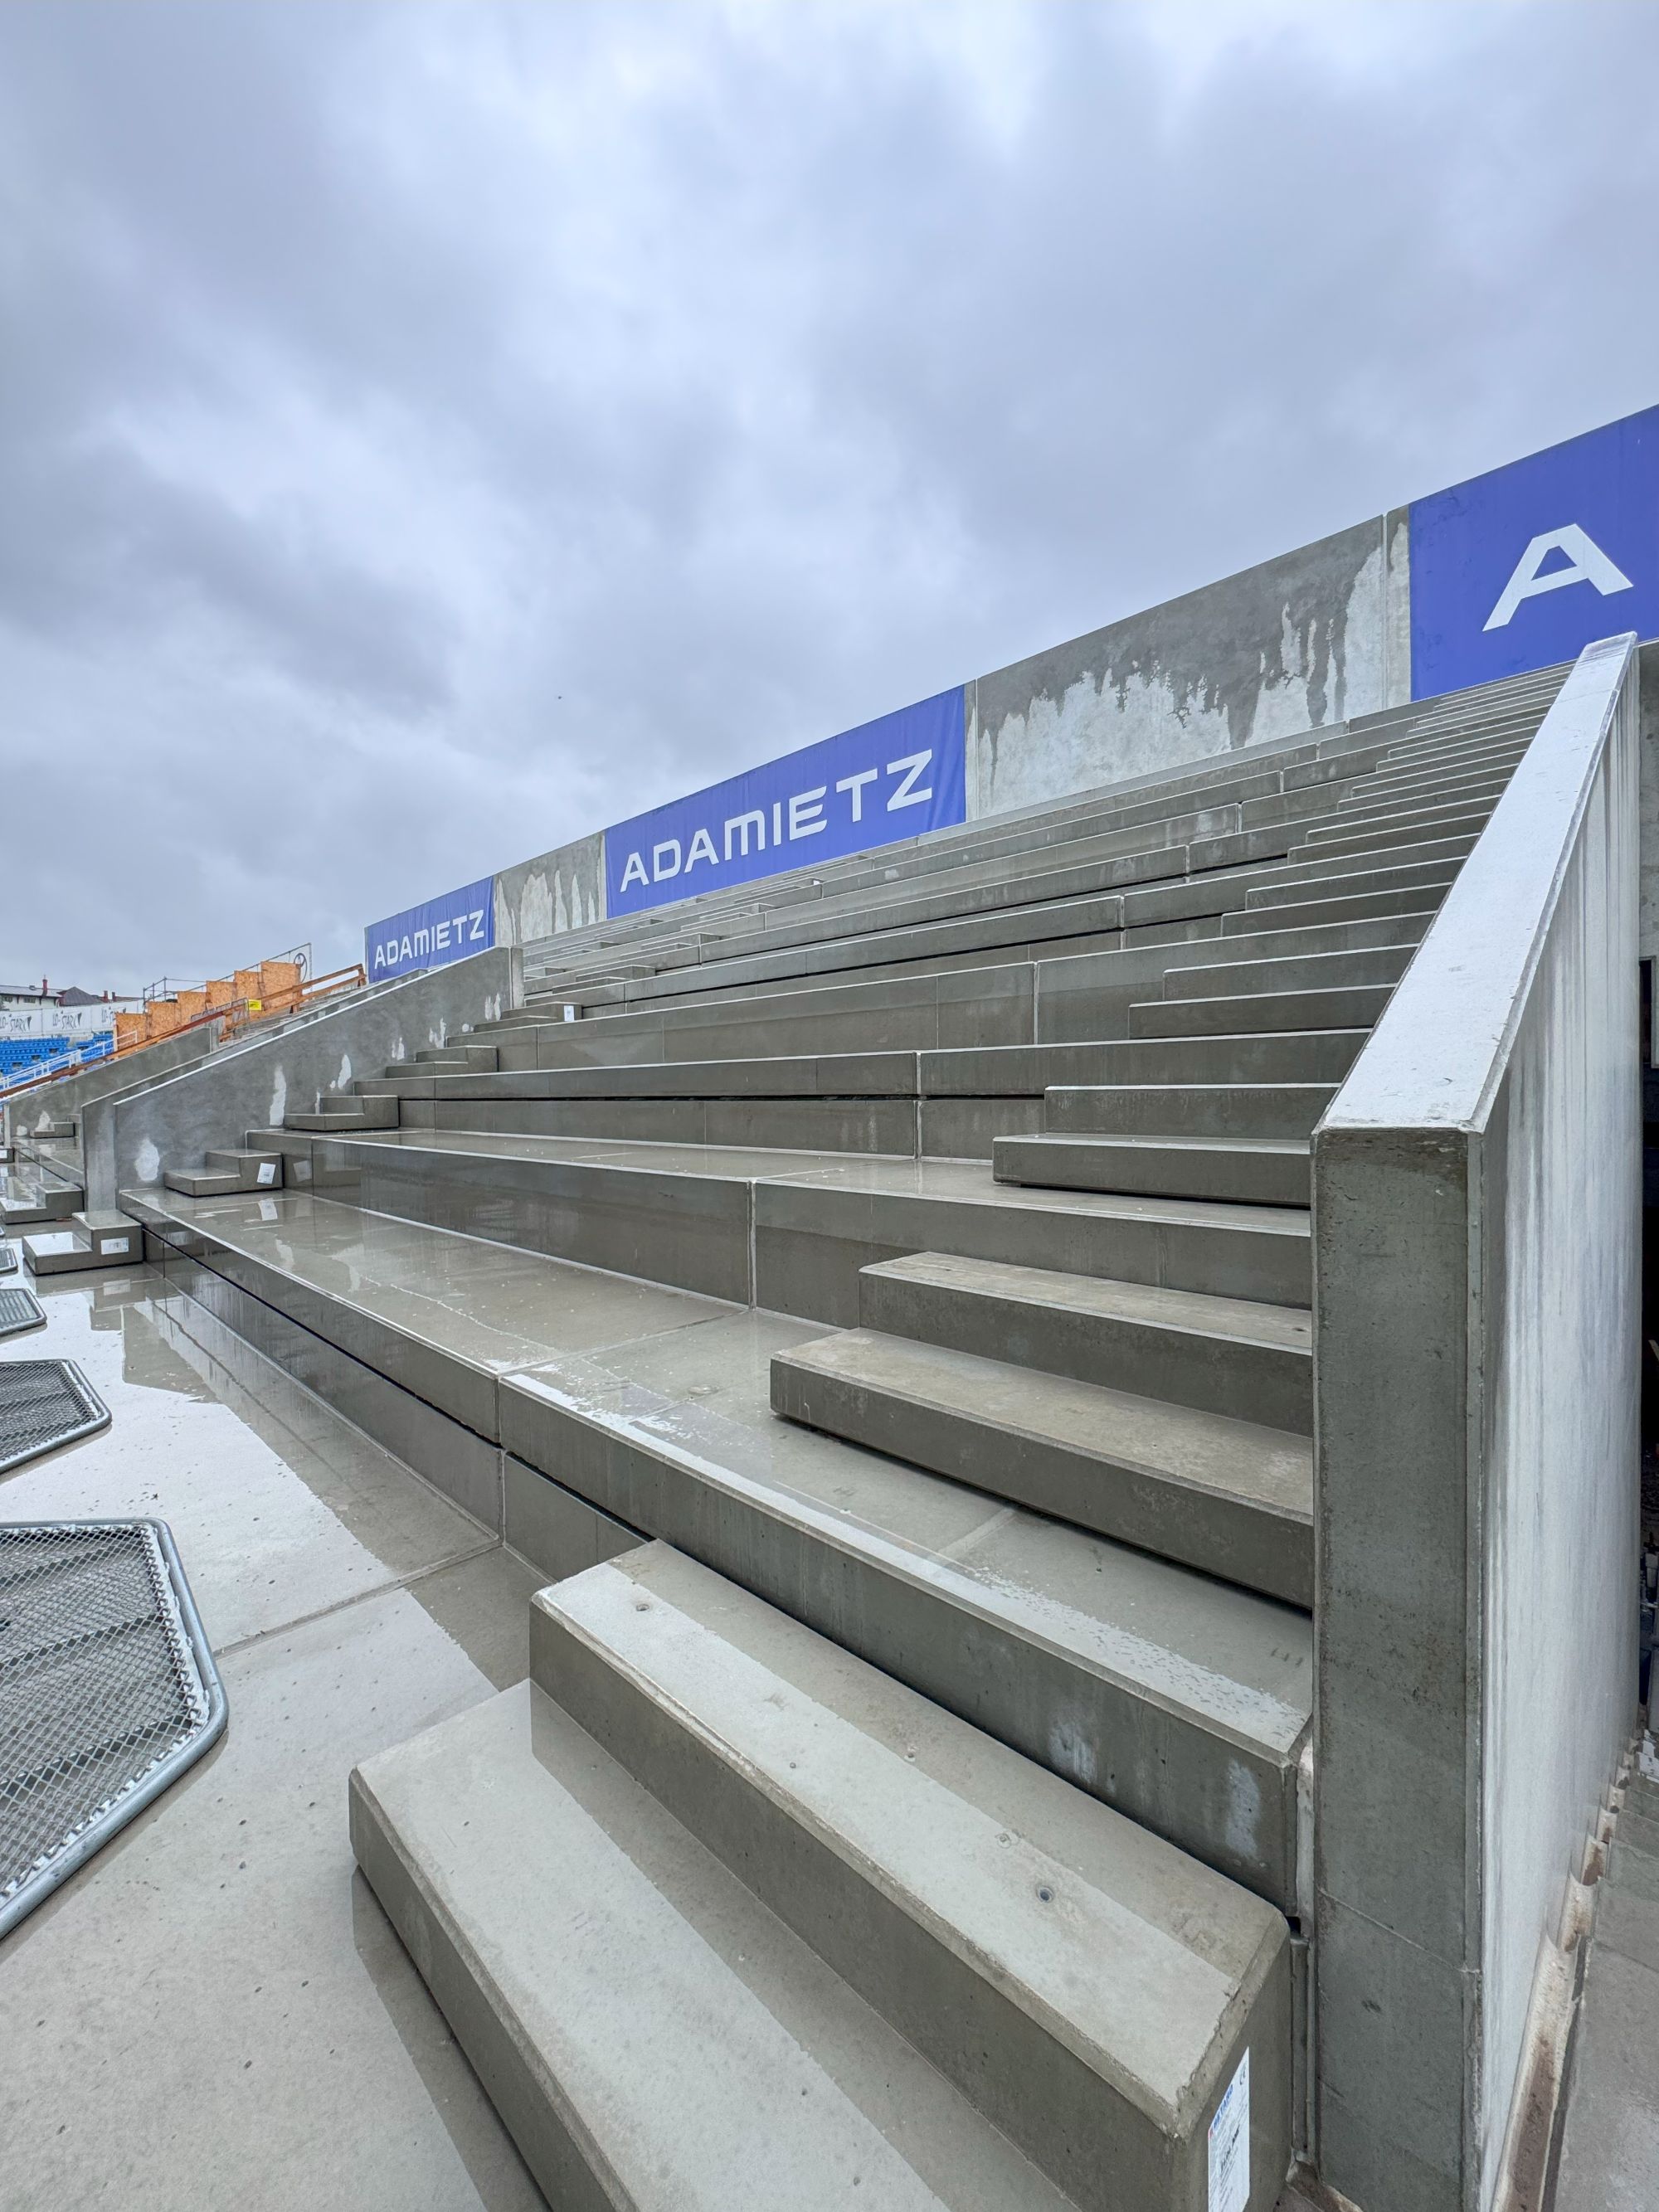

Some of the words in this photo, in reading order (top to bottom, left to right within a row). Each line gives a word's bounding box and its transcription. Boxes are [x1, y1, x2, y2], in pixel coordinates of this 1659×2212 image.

[1481, 523, 1634, 633] A
[620, 748, 933, 893] ADAMIETZ
[374, 909, 485, 970] ADAMIETZ
